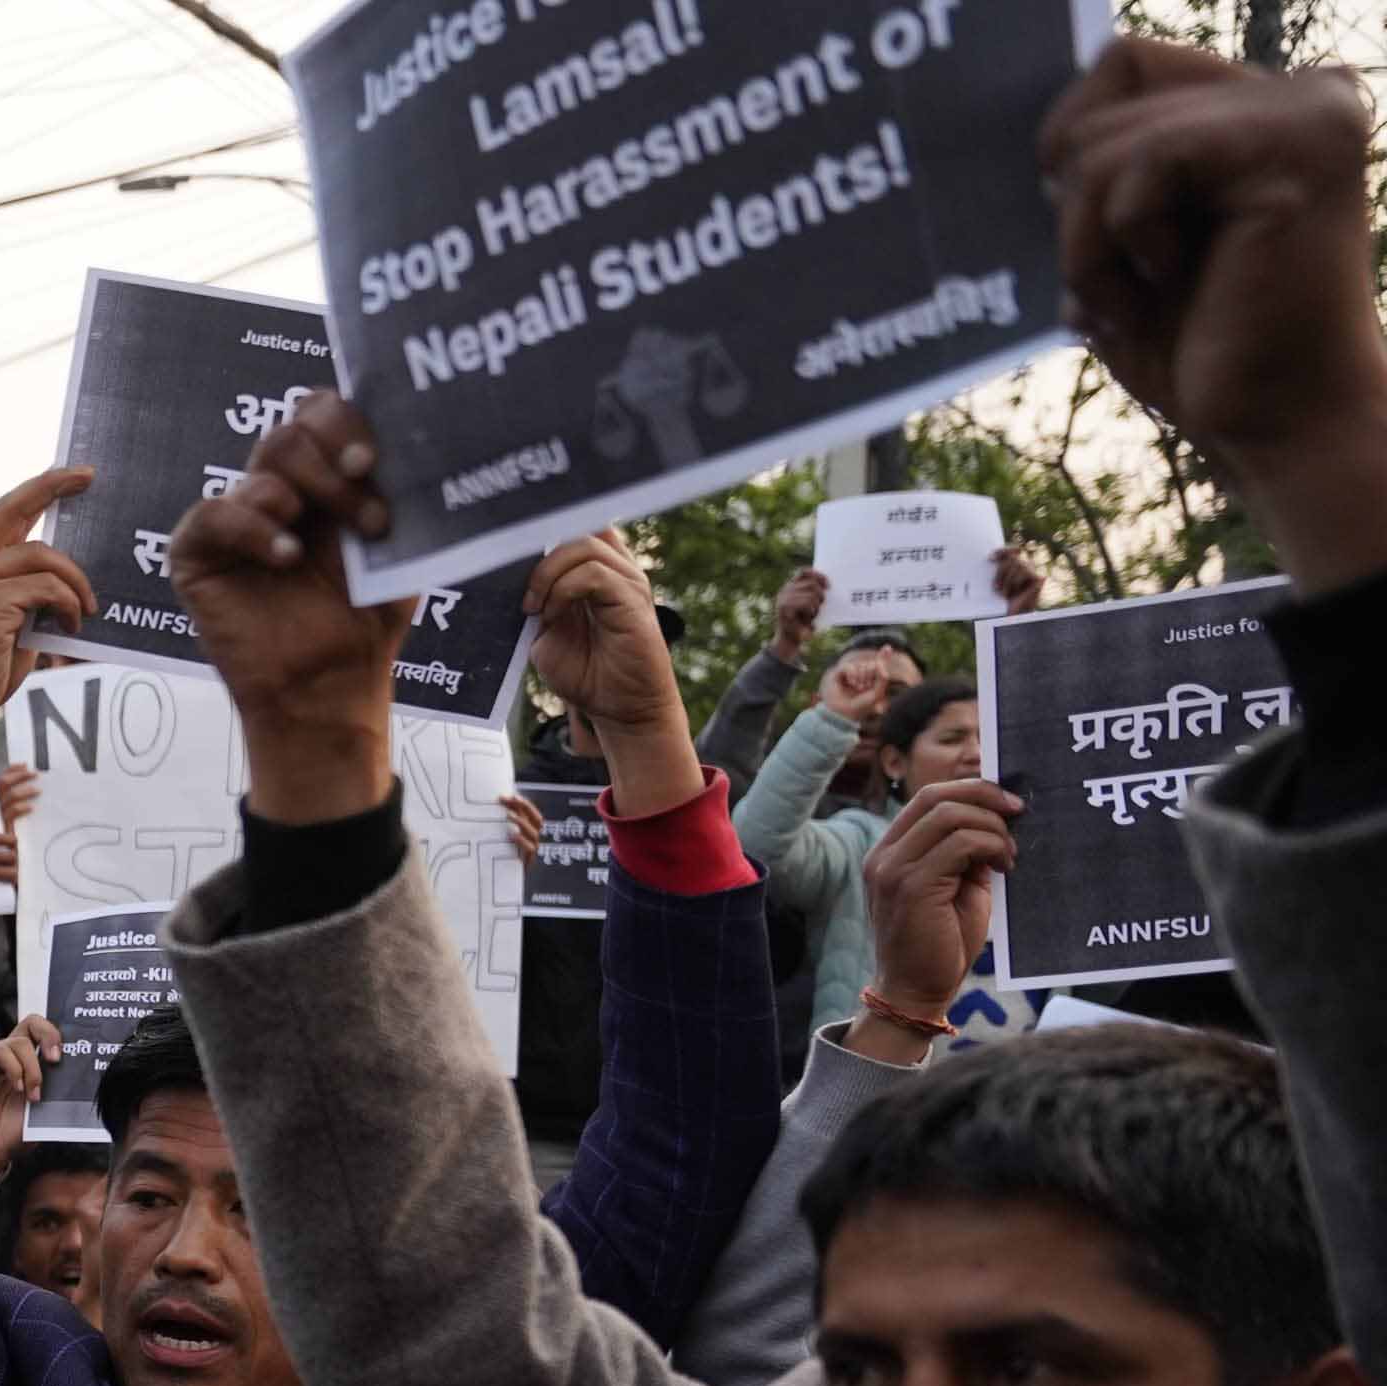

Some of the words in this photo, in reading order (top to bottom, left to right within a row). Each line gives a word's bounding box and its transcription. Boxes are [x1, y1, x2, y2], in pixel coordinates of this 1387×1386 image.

[469, 0, 704, 152] Lamsal!
[359, 226, 473, 315] Stop
[476, 37, 863, 255] Harassment
[872, 0, 960, 70] of
[401, 264, 587, 393] Nepali
[589, 121, 913, 310] Students!
[241, 329, 301, 355] Justice
[303, 337, 329, 358] for
[440, 437, 573, 512] ANNFSU
[1163, 621, 1235, 645] Justice
[1239, 617, 1265, 634] fo
[27, 671, 177, 777] NO
[1067, 683, 1229, 760] प्रकृति
[1083, 763, 1228, 826] मृत्यु
[86, 930, 156, 950] Justice
[1086, 915, 1211, 948] ANNFSU
[74, 1006, 125, 1018] Protect
